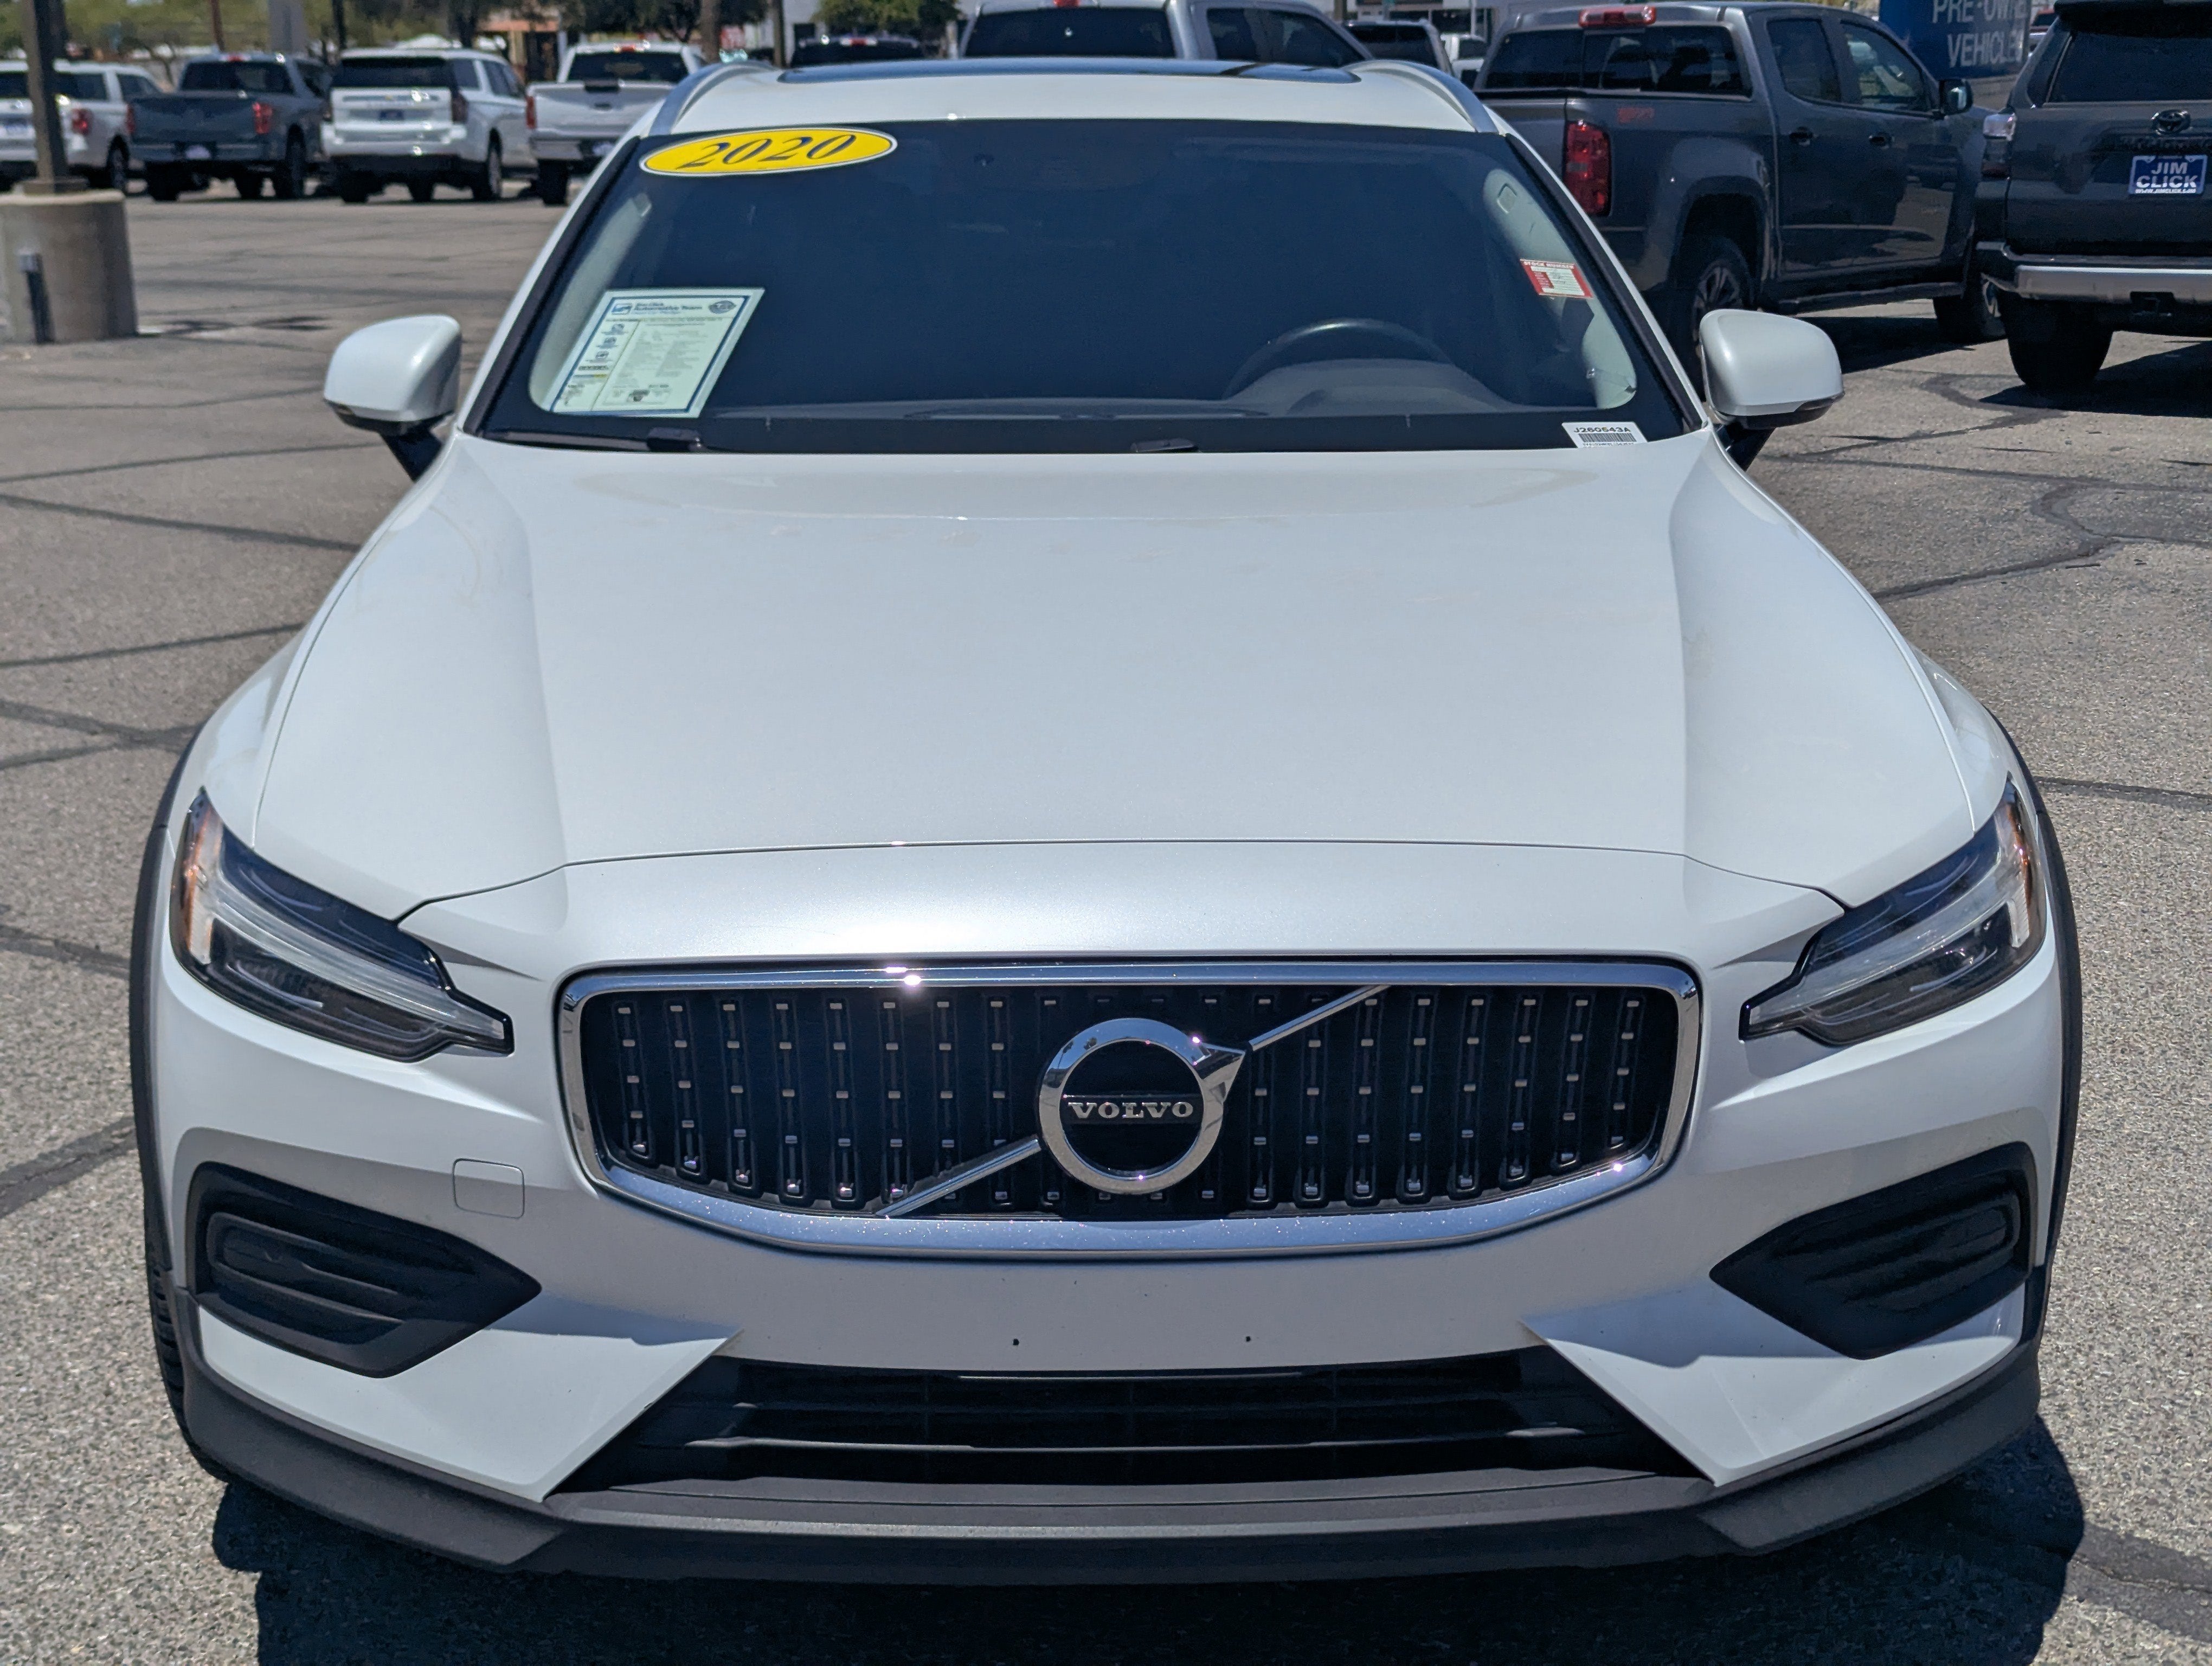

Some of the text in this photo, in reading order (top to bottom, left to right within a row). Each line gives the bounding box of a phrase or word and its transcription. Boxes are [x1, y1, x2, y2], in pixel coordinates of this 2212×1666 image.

[676, 134, 856, 170] 2020
[2151, 162, 2188, 174] JIM
[2136, 175, 2198, 188] CLICK
[1068, 1101, 1193, 1119] VOLVO
